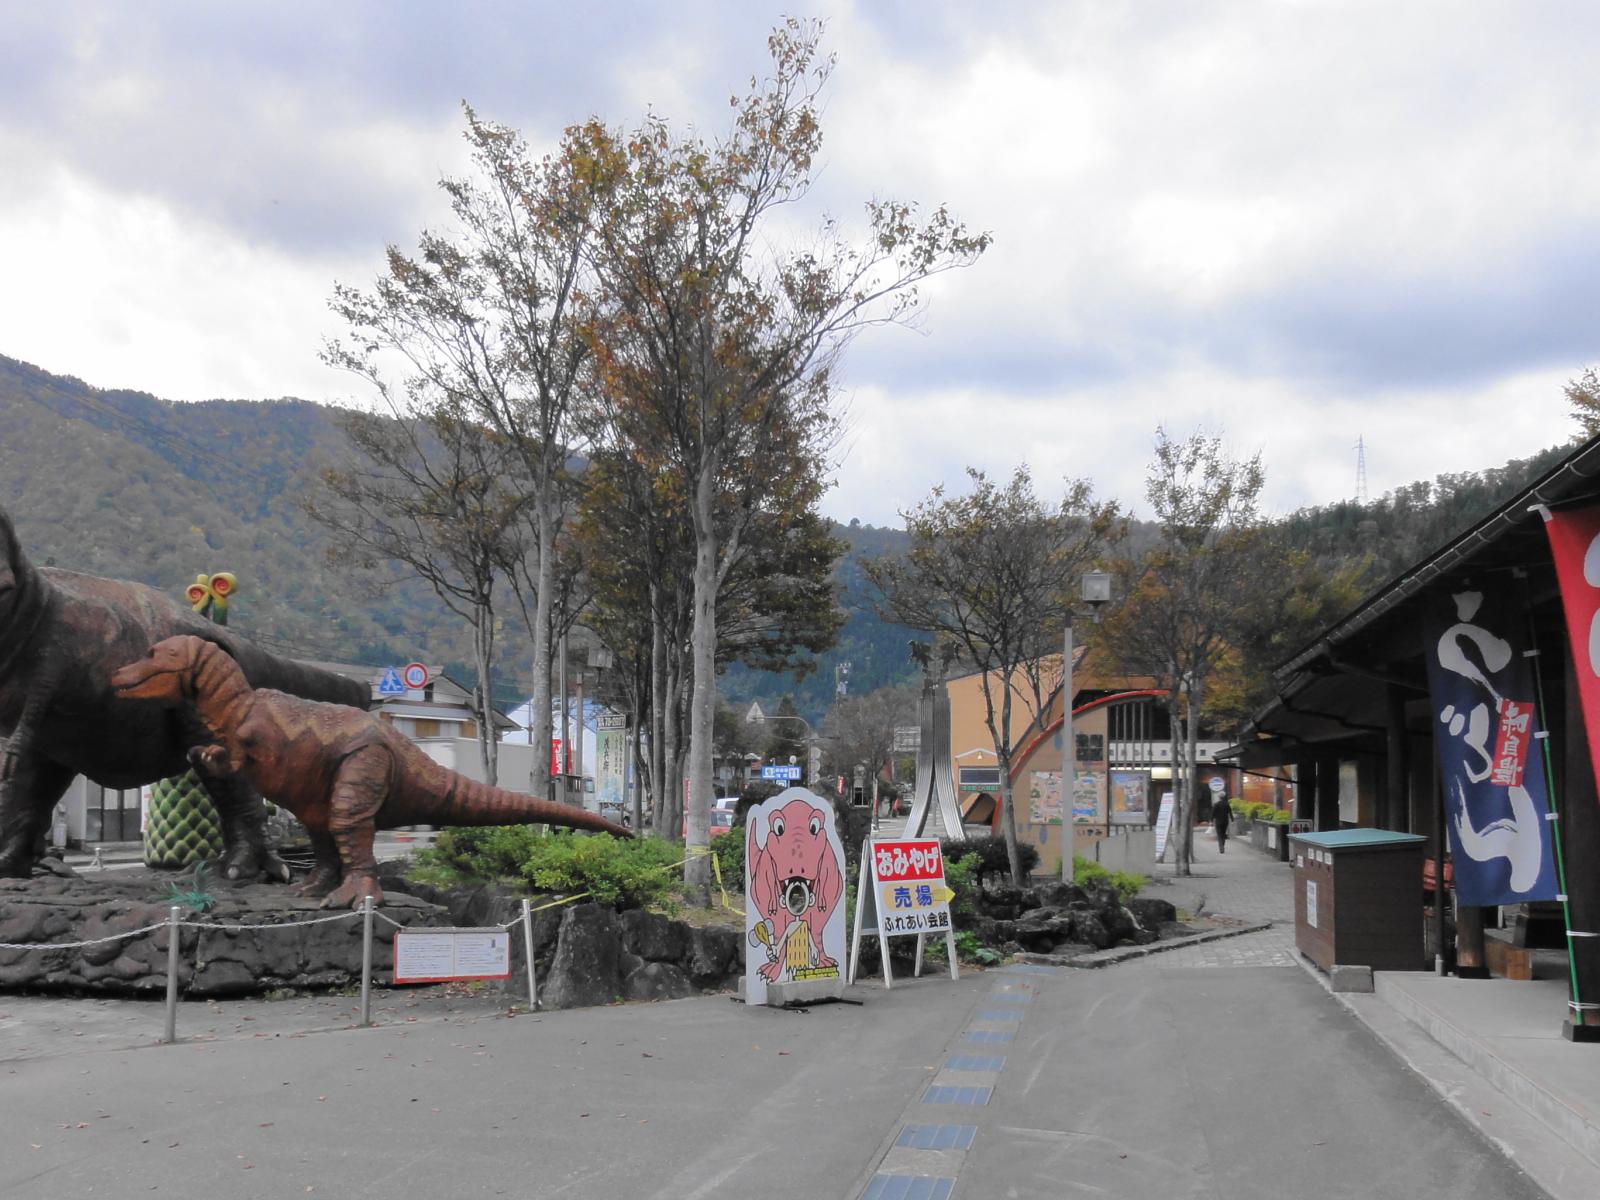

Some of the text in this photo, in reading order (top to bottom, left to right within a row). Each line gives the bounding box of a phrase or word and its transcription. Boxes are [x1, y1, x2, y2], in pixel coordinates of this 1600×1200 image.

[877, 846, 939, 877] おみやげ
[894, 885, 932, 908] 売場
[884, 911, 949, 931] ふれあい会館
